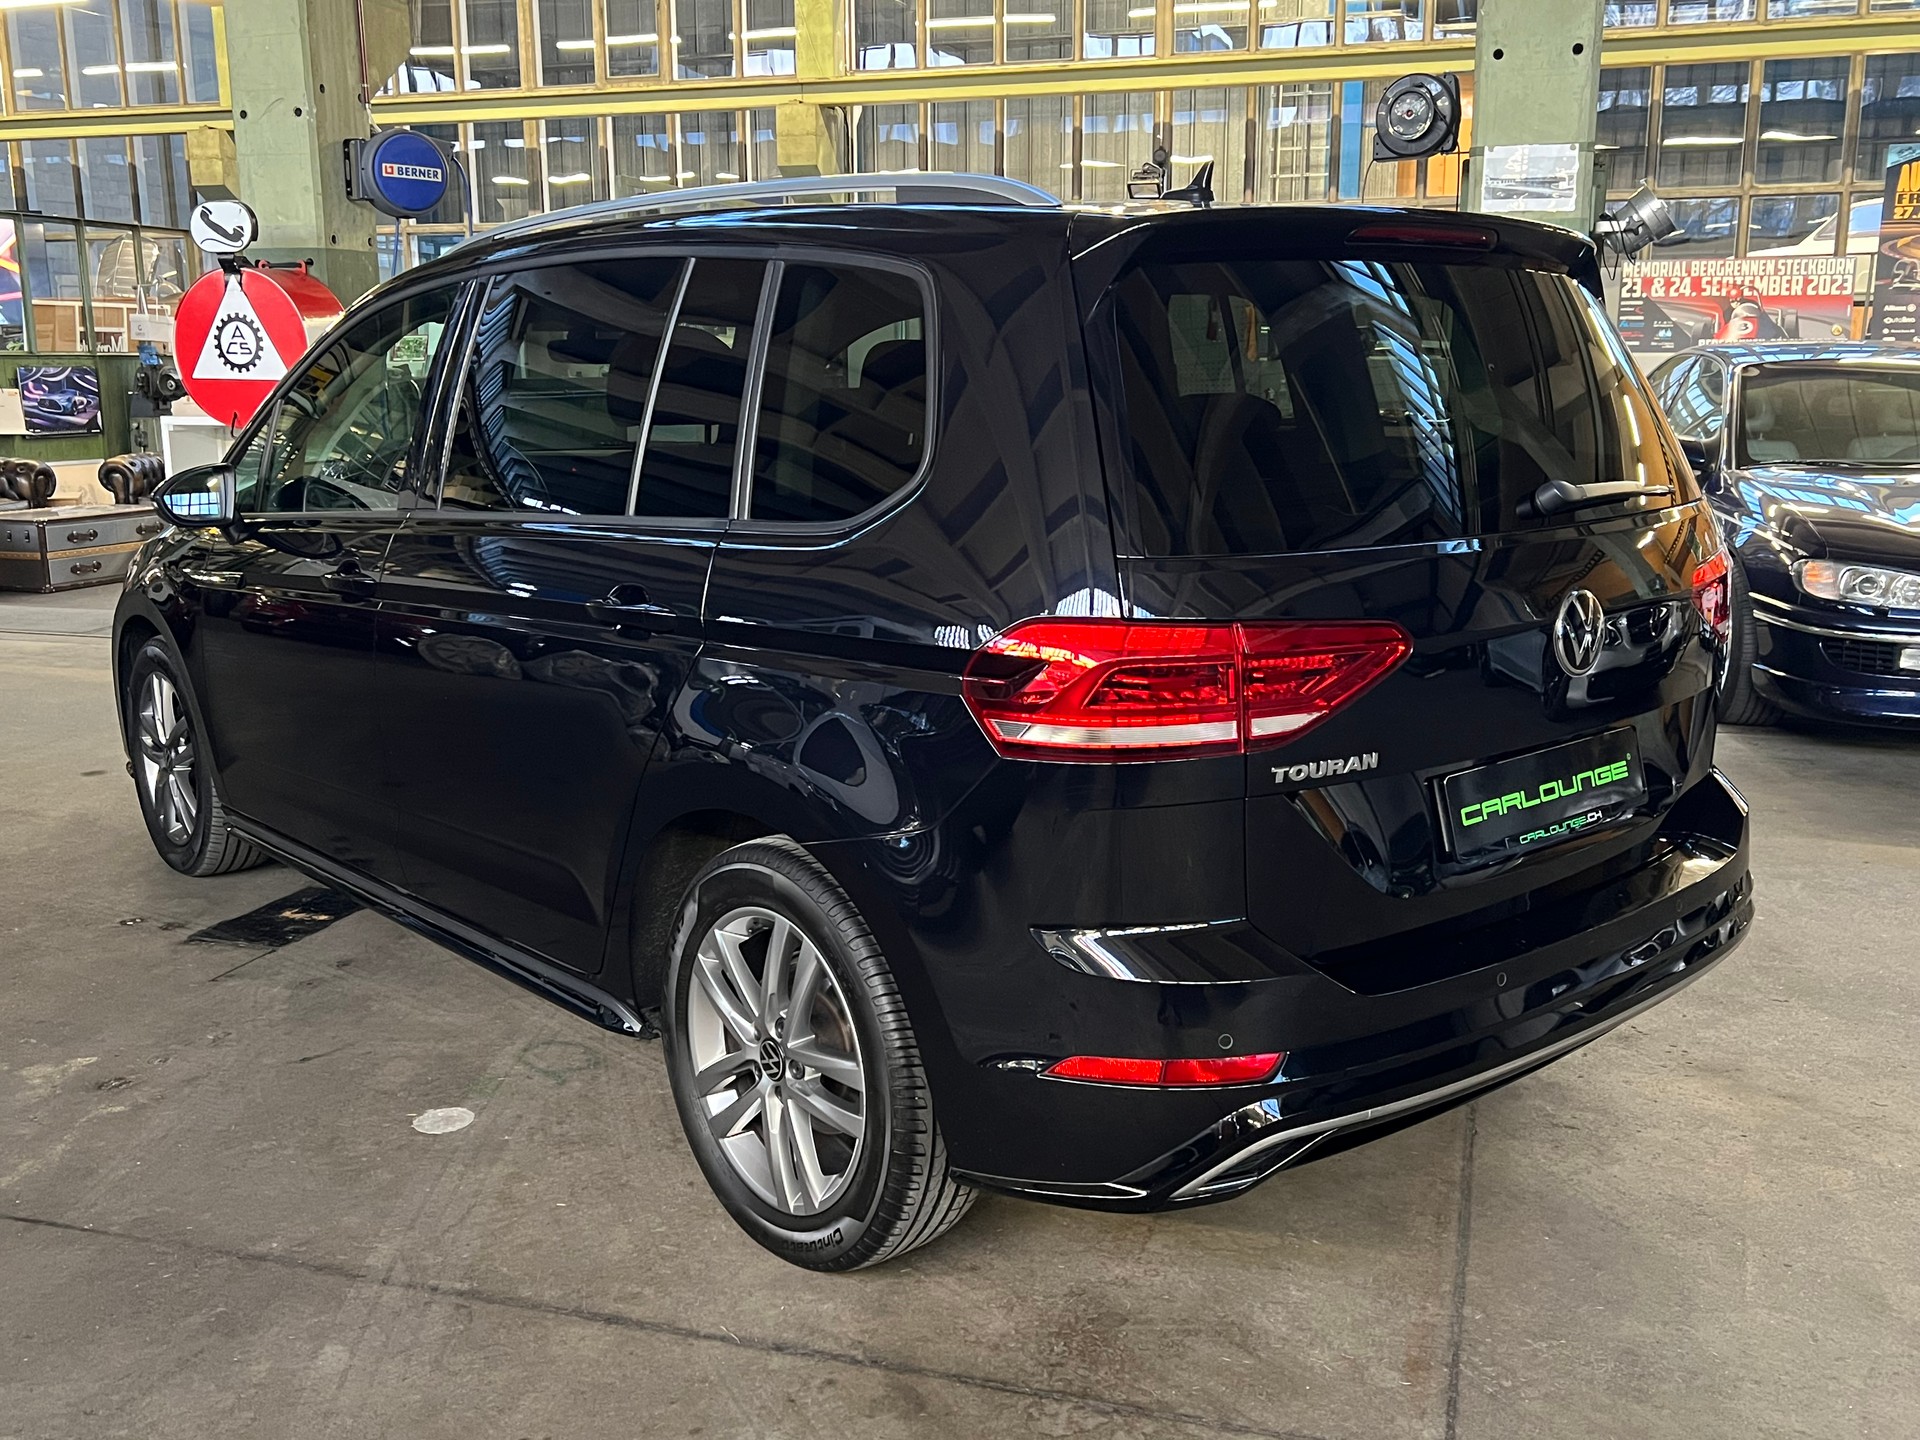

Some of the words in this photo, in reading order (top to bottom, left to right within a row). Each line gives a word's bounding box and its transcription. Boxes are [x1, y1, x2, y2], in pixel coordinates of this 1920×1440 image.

[397, 165, 440, 180] BERNER
[1622, 261, 1689, 278] MEMORIAL
[1690, 259, 1776, 277] BERGRENNEN
[1777, 258, 1854, 276] STECKBORN
[1620, 277, 1648, 298] 23.
[1650, 277, 1666, 297] &
[1668, 276, 1697, 298] 24.
[1805, 274, 1854, 297] 2023
[1271, 752, 1379, 784] TOURAN
[1519, 810, 1603, 845] CARLOUNGE.CH
